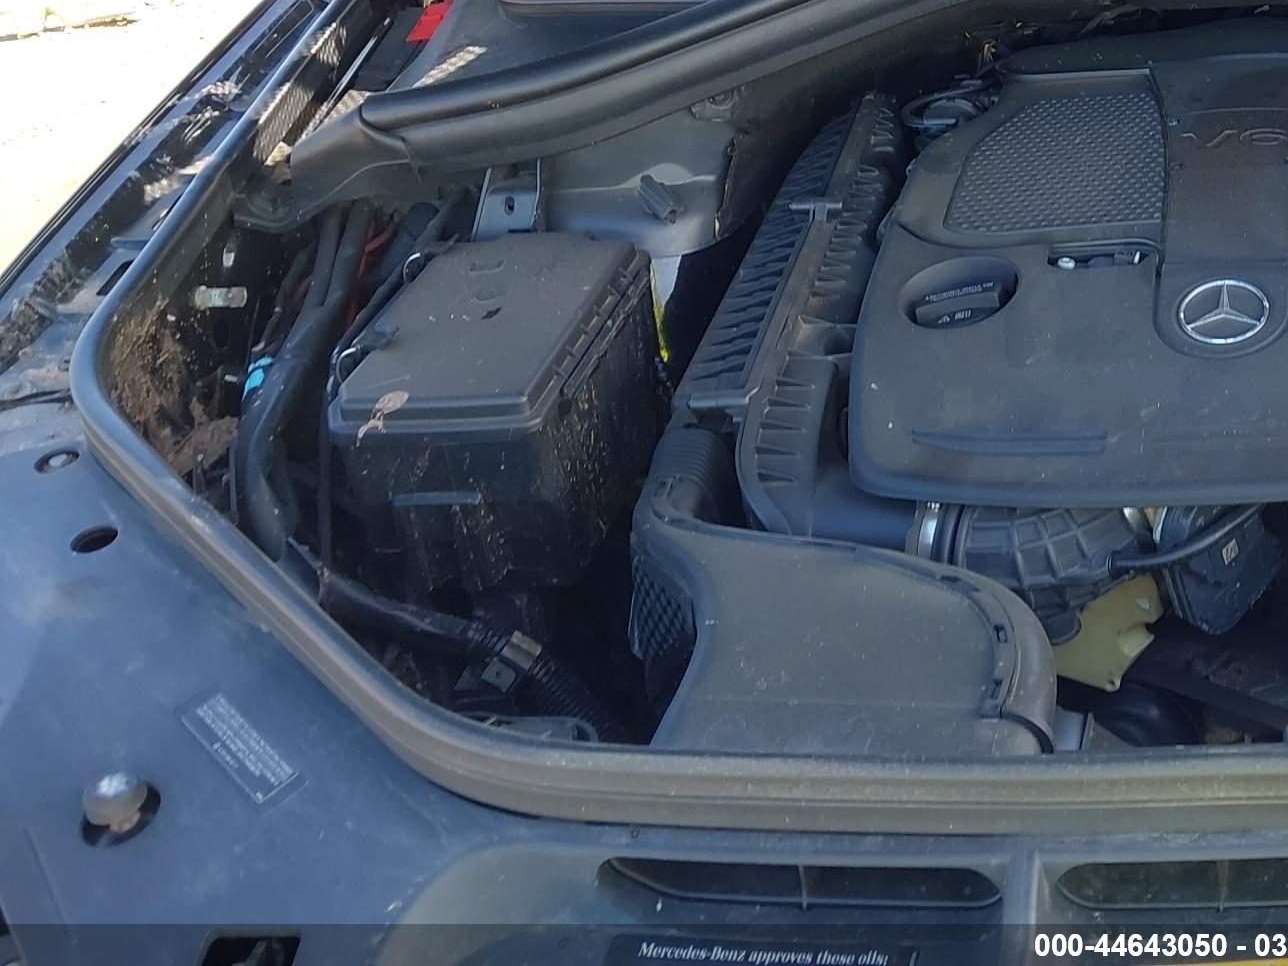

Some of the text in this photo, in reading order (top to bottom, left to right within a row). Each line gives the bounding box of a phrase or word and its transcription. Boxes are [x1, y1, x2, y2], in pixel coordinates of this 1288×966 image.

[1181, 128, 1288, 147] V6
[638, 941, 746, 963] Mercedes-Benz
[747, 948, 813, 966] approves
[816, 948, 855, 966] these
